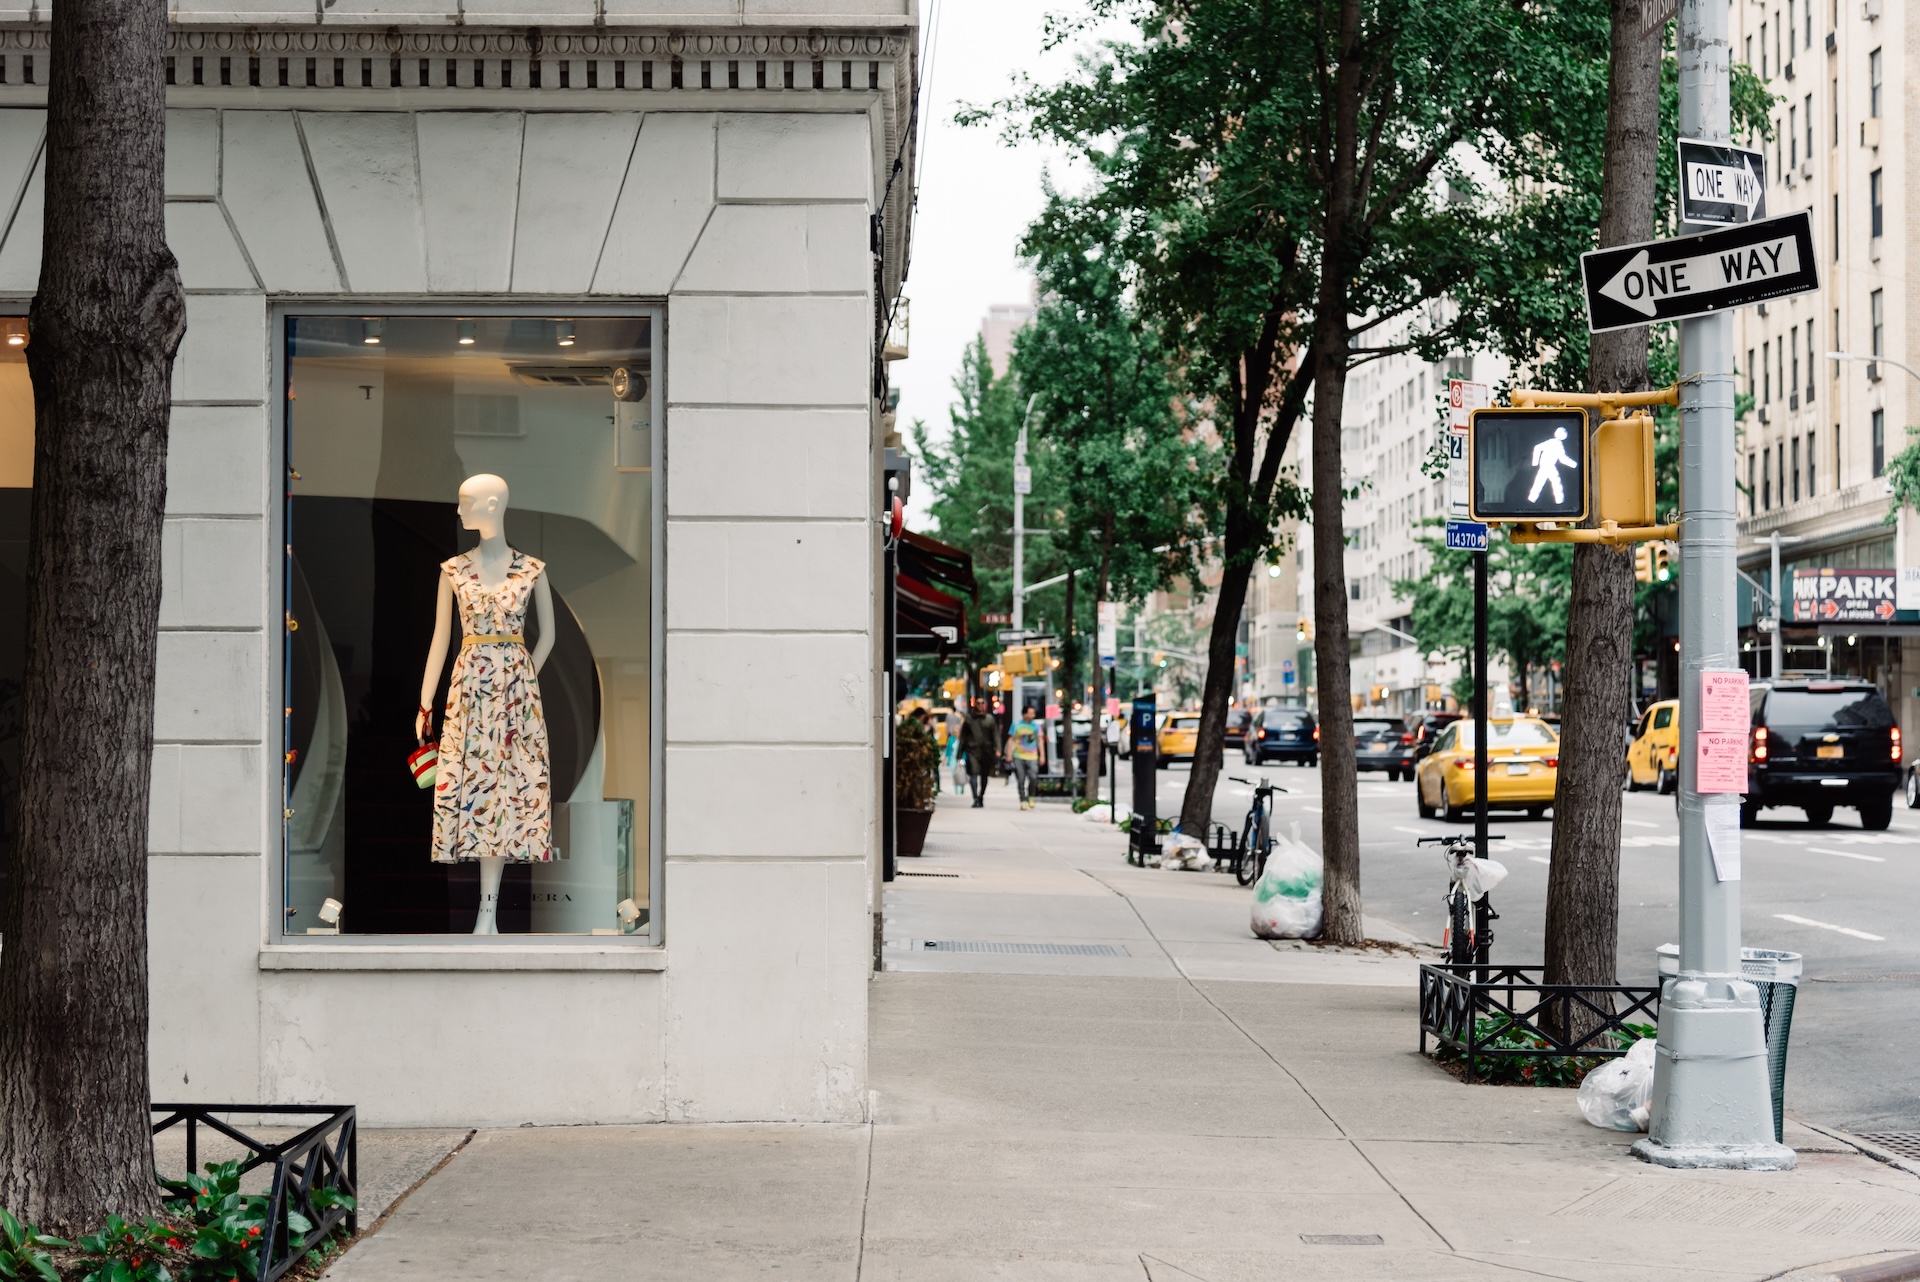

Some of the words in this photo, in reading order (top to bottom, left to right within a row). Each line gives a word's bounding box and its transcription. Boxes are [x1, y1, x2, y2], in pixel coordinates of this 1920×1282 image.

[1696, 167, 1725, 199] ONE
[1734, 172, 1755, 204] WAY
[1624, 263, 1691, 300] ONE
[1720, 242, 1784, 284] WAY
[1761, 284, 1810, 298] TRANSPORTATION
[1453, 437, 1460, 458] 2
[1448, 532, 1476, 547] 114370
[1793, 577, 1818, 599] PARK
[1820, 576, 1895, 599] PARK
[1846, 600, 1869, 609] OPEN
[1848, 610, 1875, 619] HOURS
[1712, 677, 1723, 685] NO
[1724, 678, 1745, 686] PARKING
